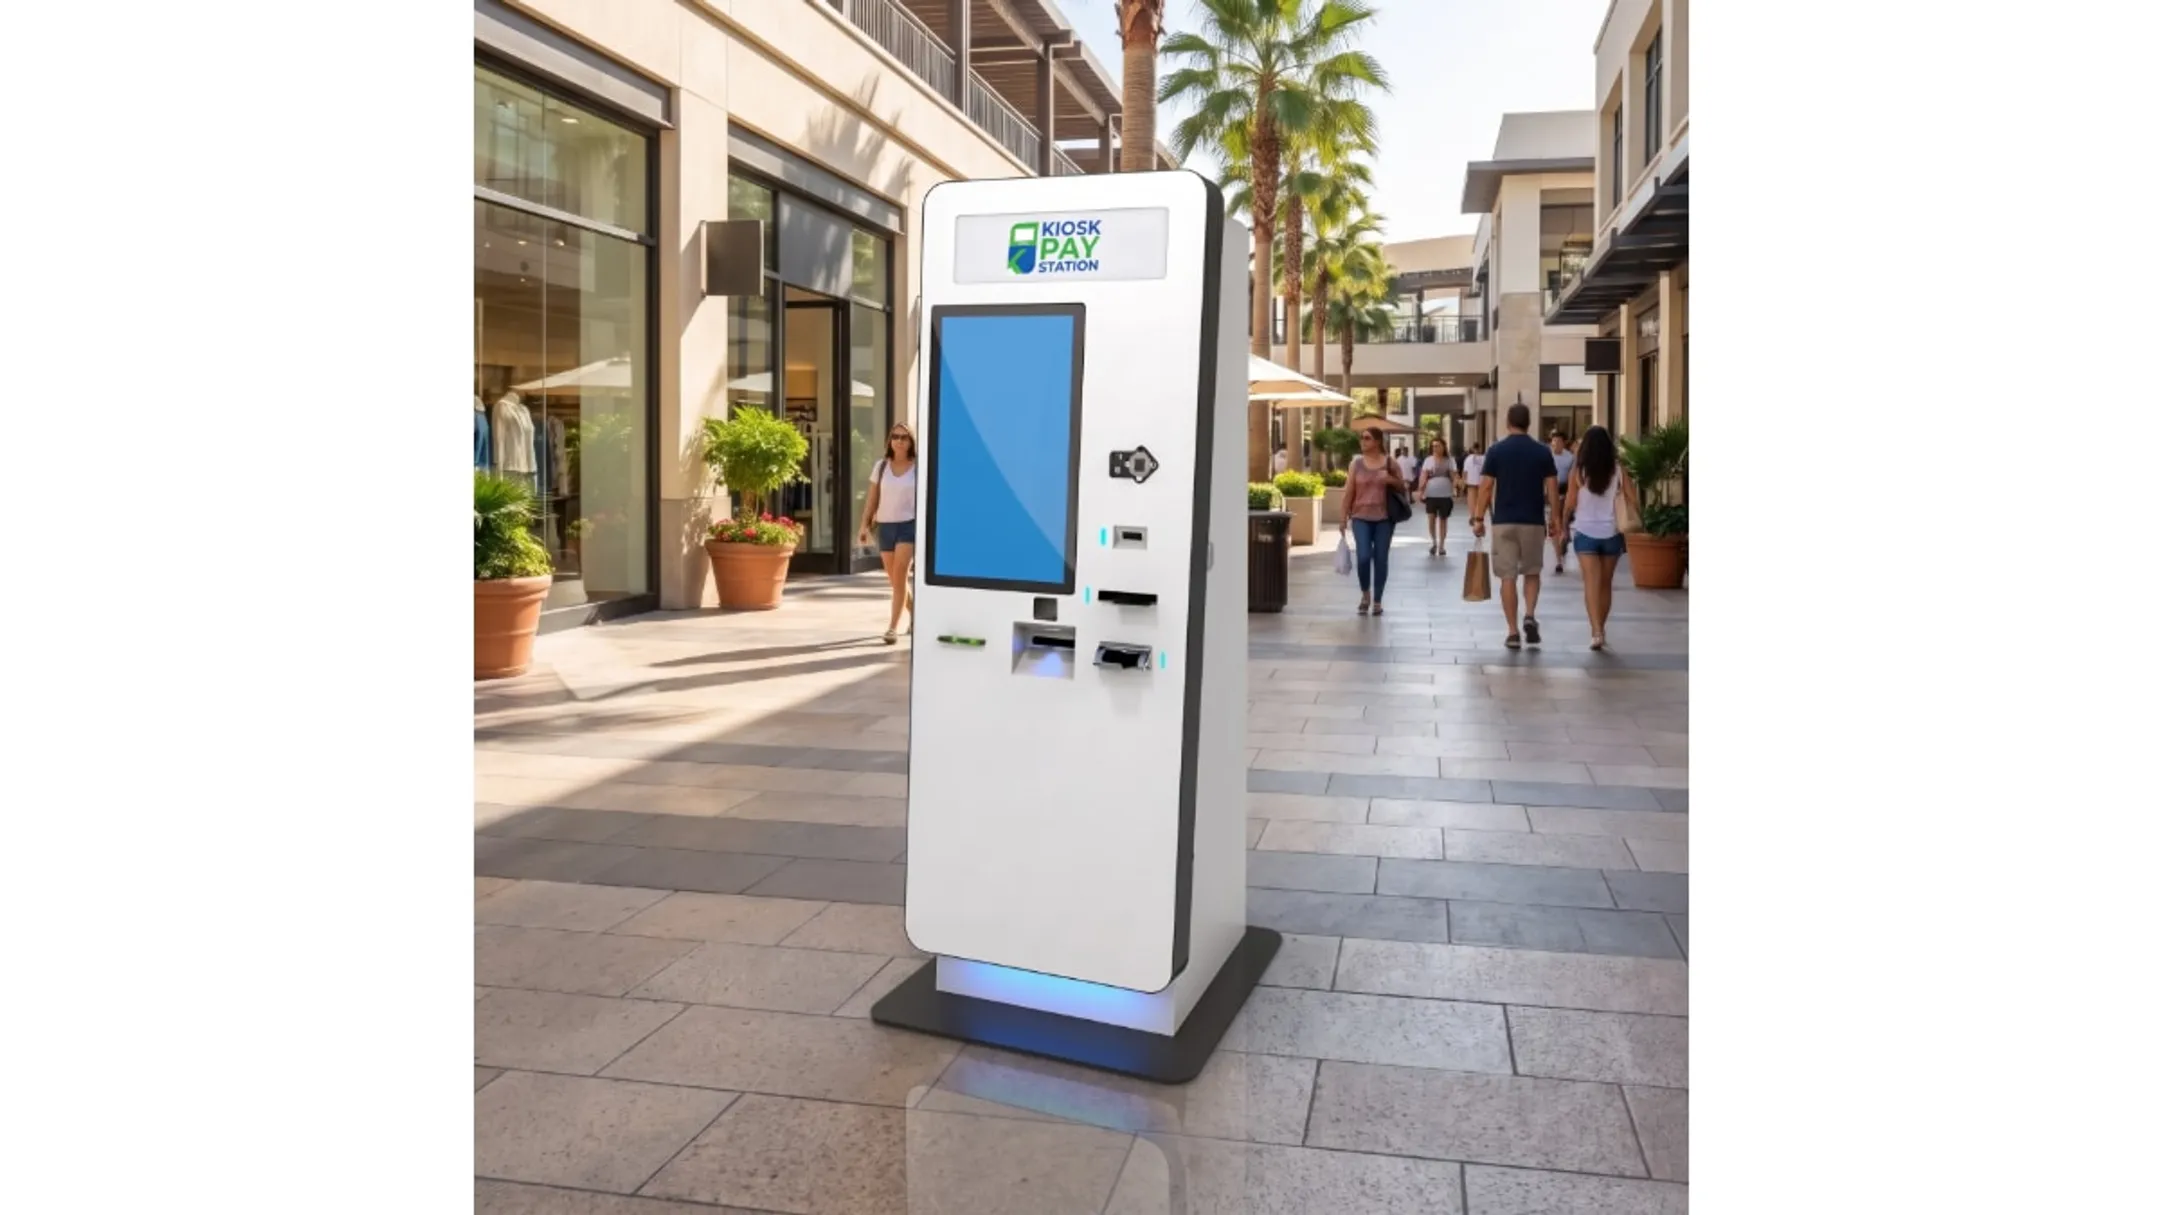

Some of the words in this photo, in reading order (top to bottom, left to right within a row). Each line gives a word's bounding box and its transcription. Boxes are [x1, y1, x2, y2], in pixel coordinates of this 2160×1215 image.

[1041, 220, 1102, 236] KIOSK
[1040, 236, 1100, 260] PAY
[1038, 260, 1099, 273] STATION
